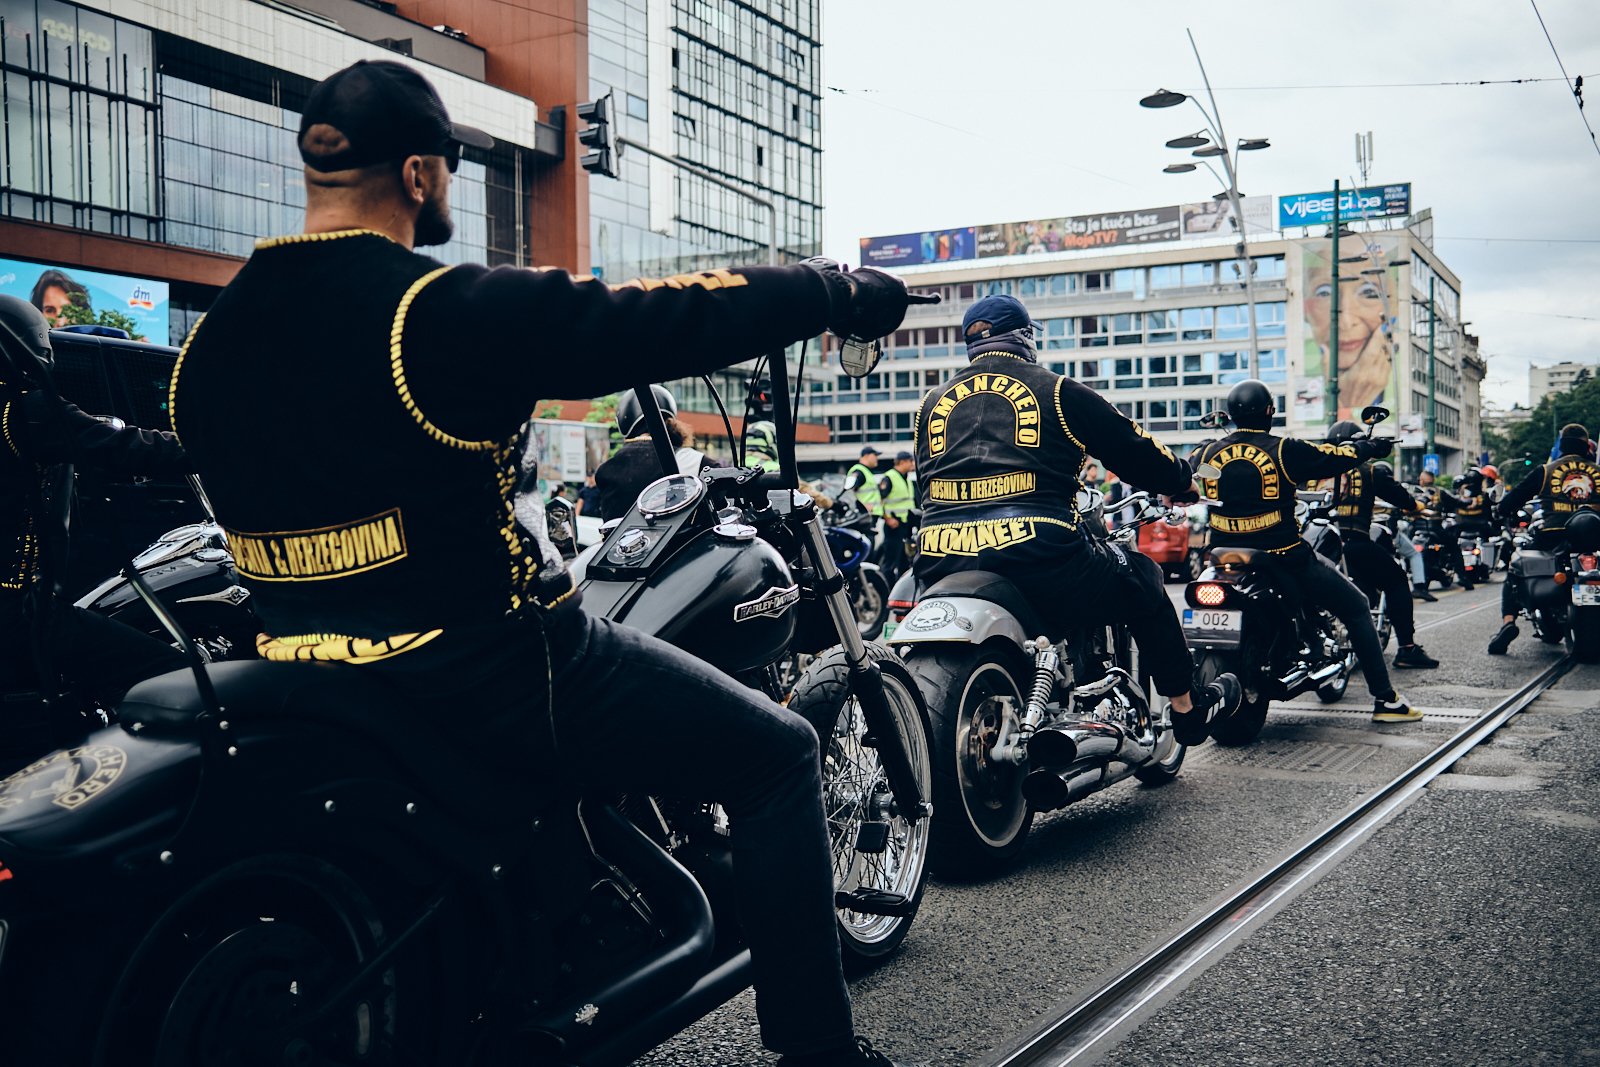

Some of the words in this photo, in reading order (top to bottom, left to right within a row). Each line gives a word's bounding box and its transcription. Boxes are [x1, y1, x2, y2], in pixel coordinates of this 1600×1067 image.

[1283, 191, 1381, 218] vijesti.ba
[1064, 217, 1086, 234] Šta
[1087, 217, 1100, 235] je
[1101, 214, 1132, 230] kuća
[1134, 212, 1158, 227] bez
[1064, 229, 1119, 248] MojeTV?
[133, 286, 150, 301] dm
[930, 375, 1038, 453] COMANCHERO
[931, 480, 959, 500] BOSNIA
[960, 481, 968, 500] &
[970, 472, 1033, 500] HERZEGOVINA
[270, 539, 289, 576] &
[284, 516, 401, 576] HERZEGOVINA
[923, 521, 1028, 554] NOMNEE
[1202, 612, 1229, 626] 002
